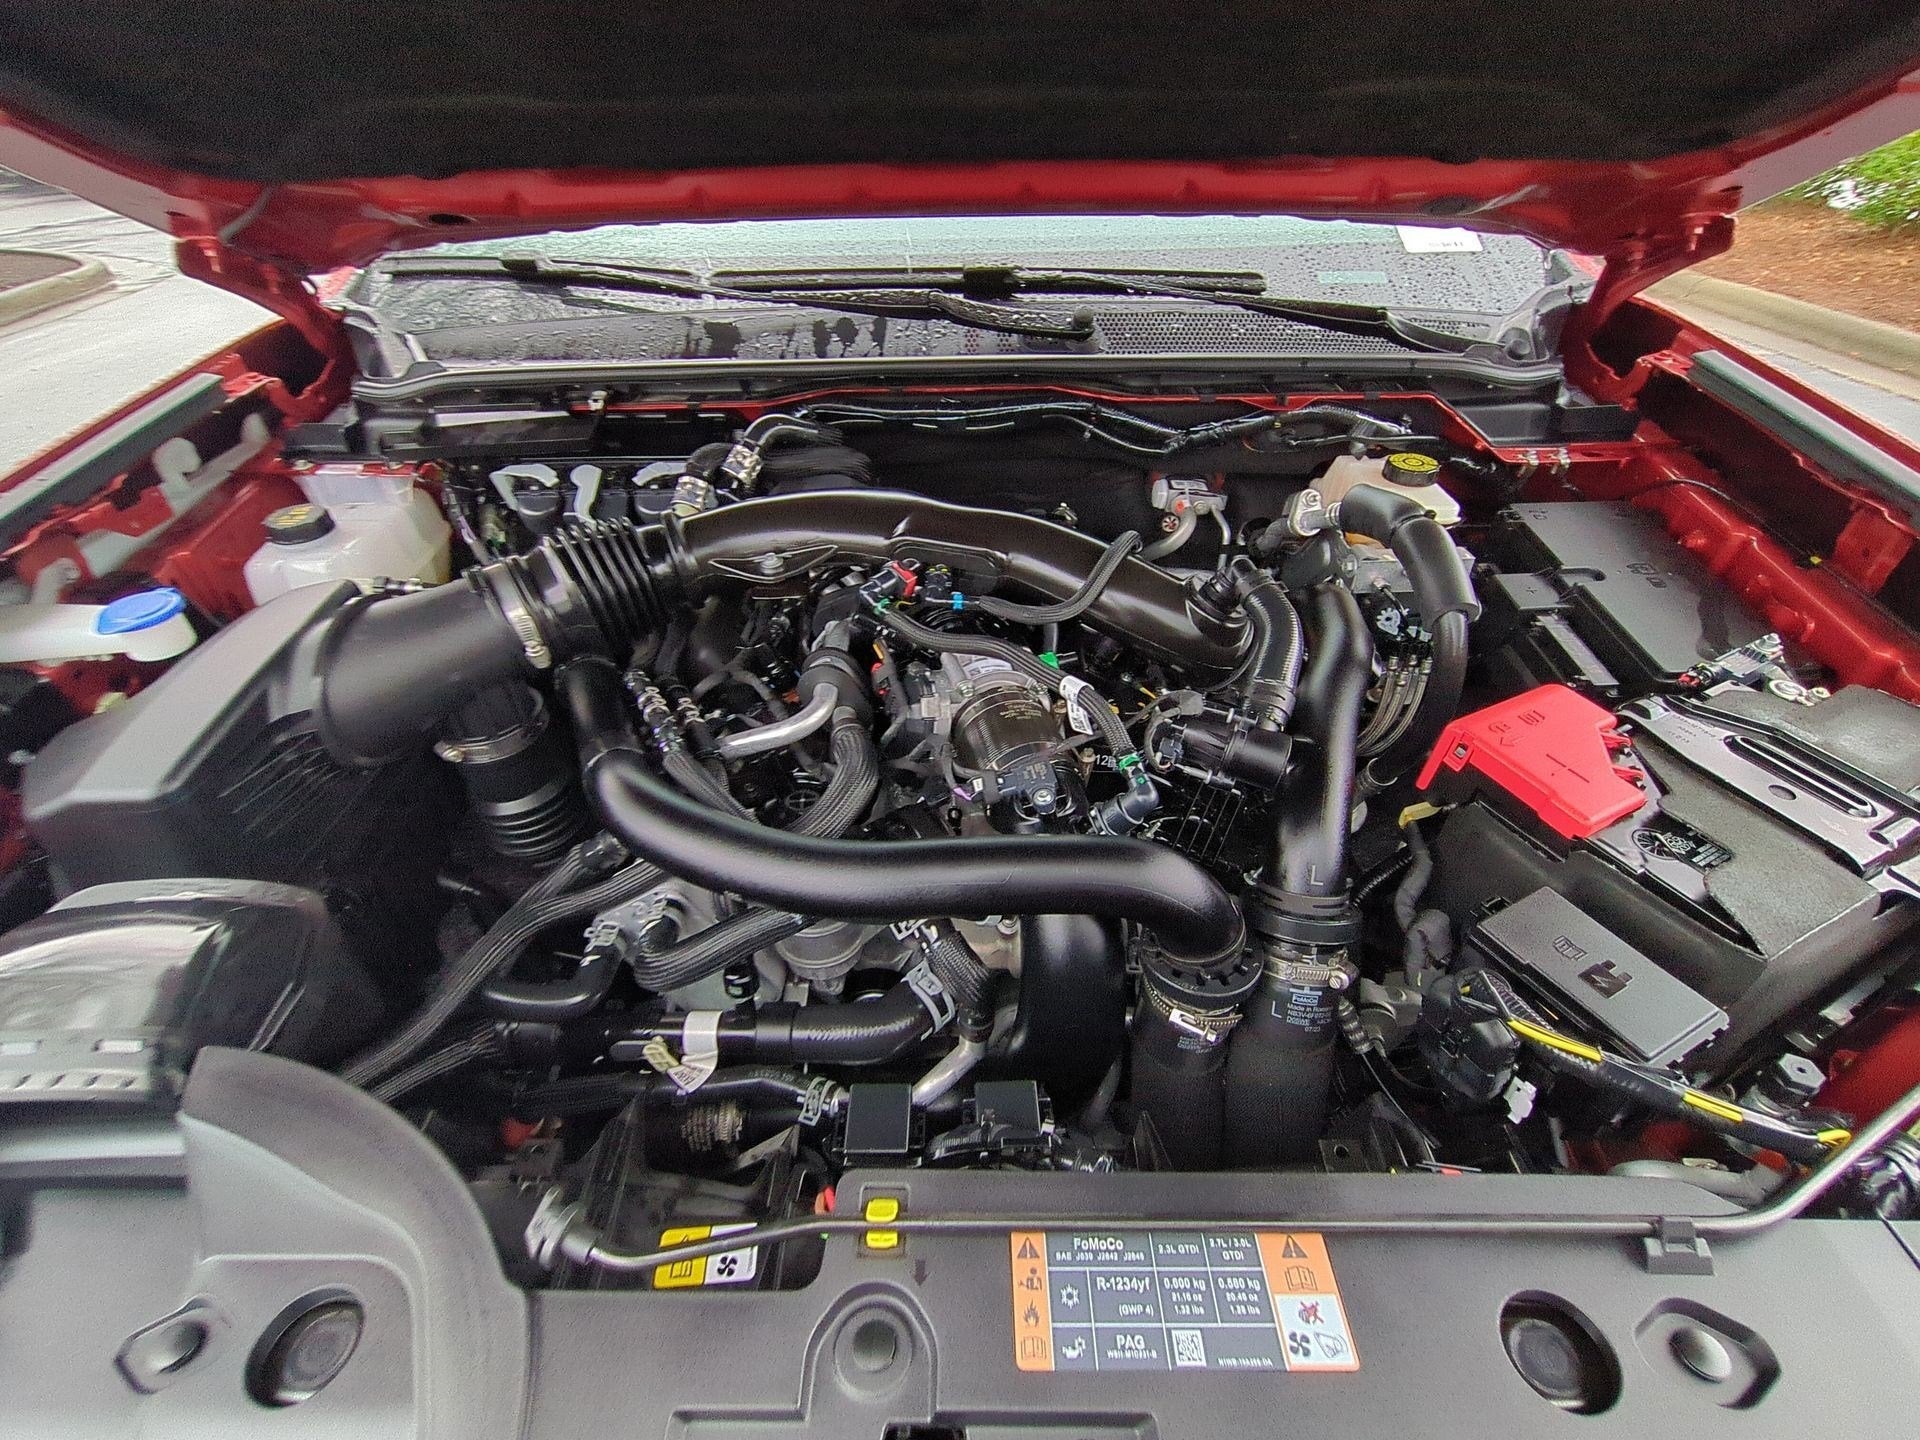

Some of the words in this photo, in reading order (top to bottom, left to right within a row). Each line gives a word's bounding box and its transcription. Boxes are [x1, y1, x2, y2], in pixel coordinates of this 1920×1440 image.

[1311, 864, 1323, 886] L
[1271, 1001, 1282, 1019] L
[1074, 1237, 1124, 1251] FoMoCo
[1222, 1250, 1245, 1260] GTDI
[1096, 1276, 1150, 1294] R-1234yf
[1163, 1277, 1191, 1290] 0.600
[1192, 1277, 1206, 1291] kg
[1247, 1277, 1261, 1291] kg
[1193, 1294, 1203, 1302] oz
[1249, 1294, 1259, 1302] oz
[1116, 1334, 1146, 1350] PAG
